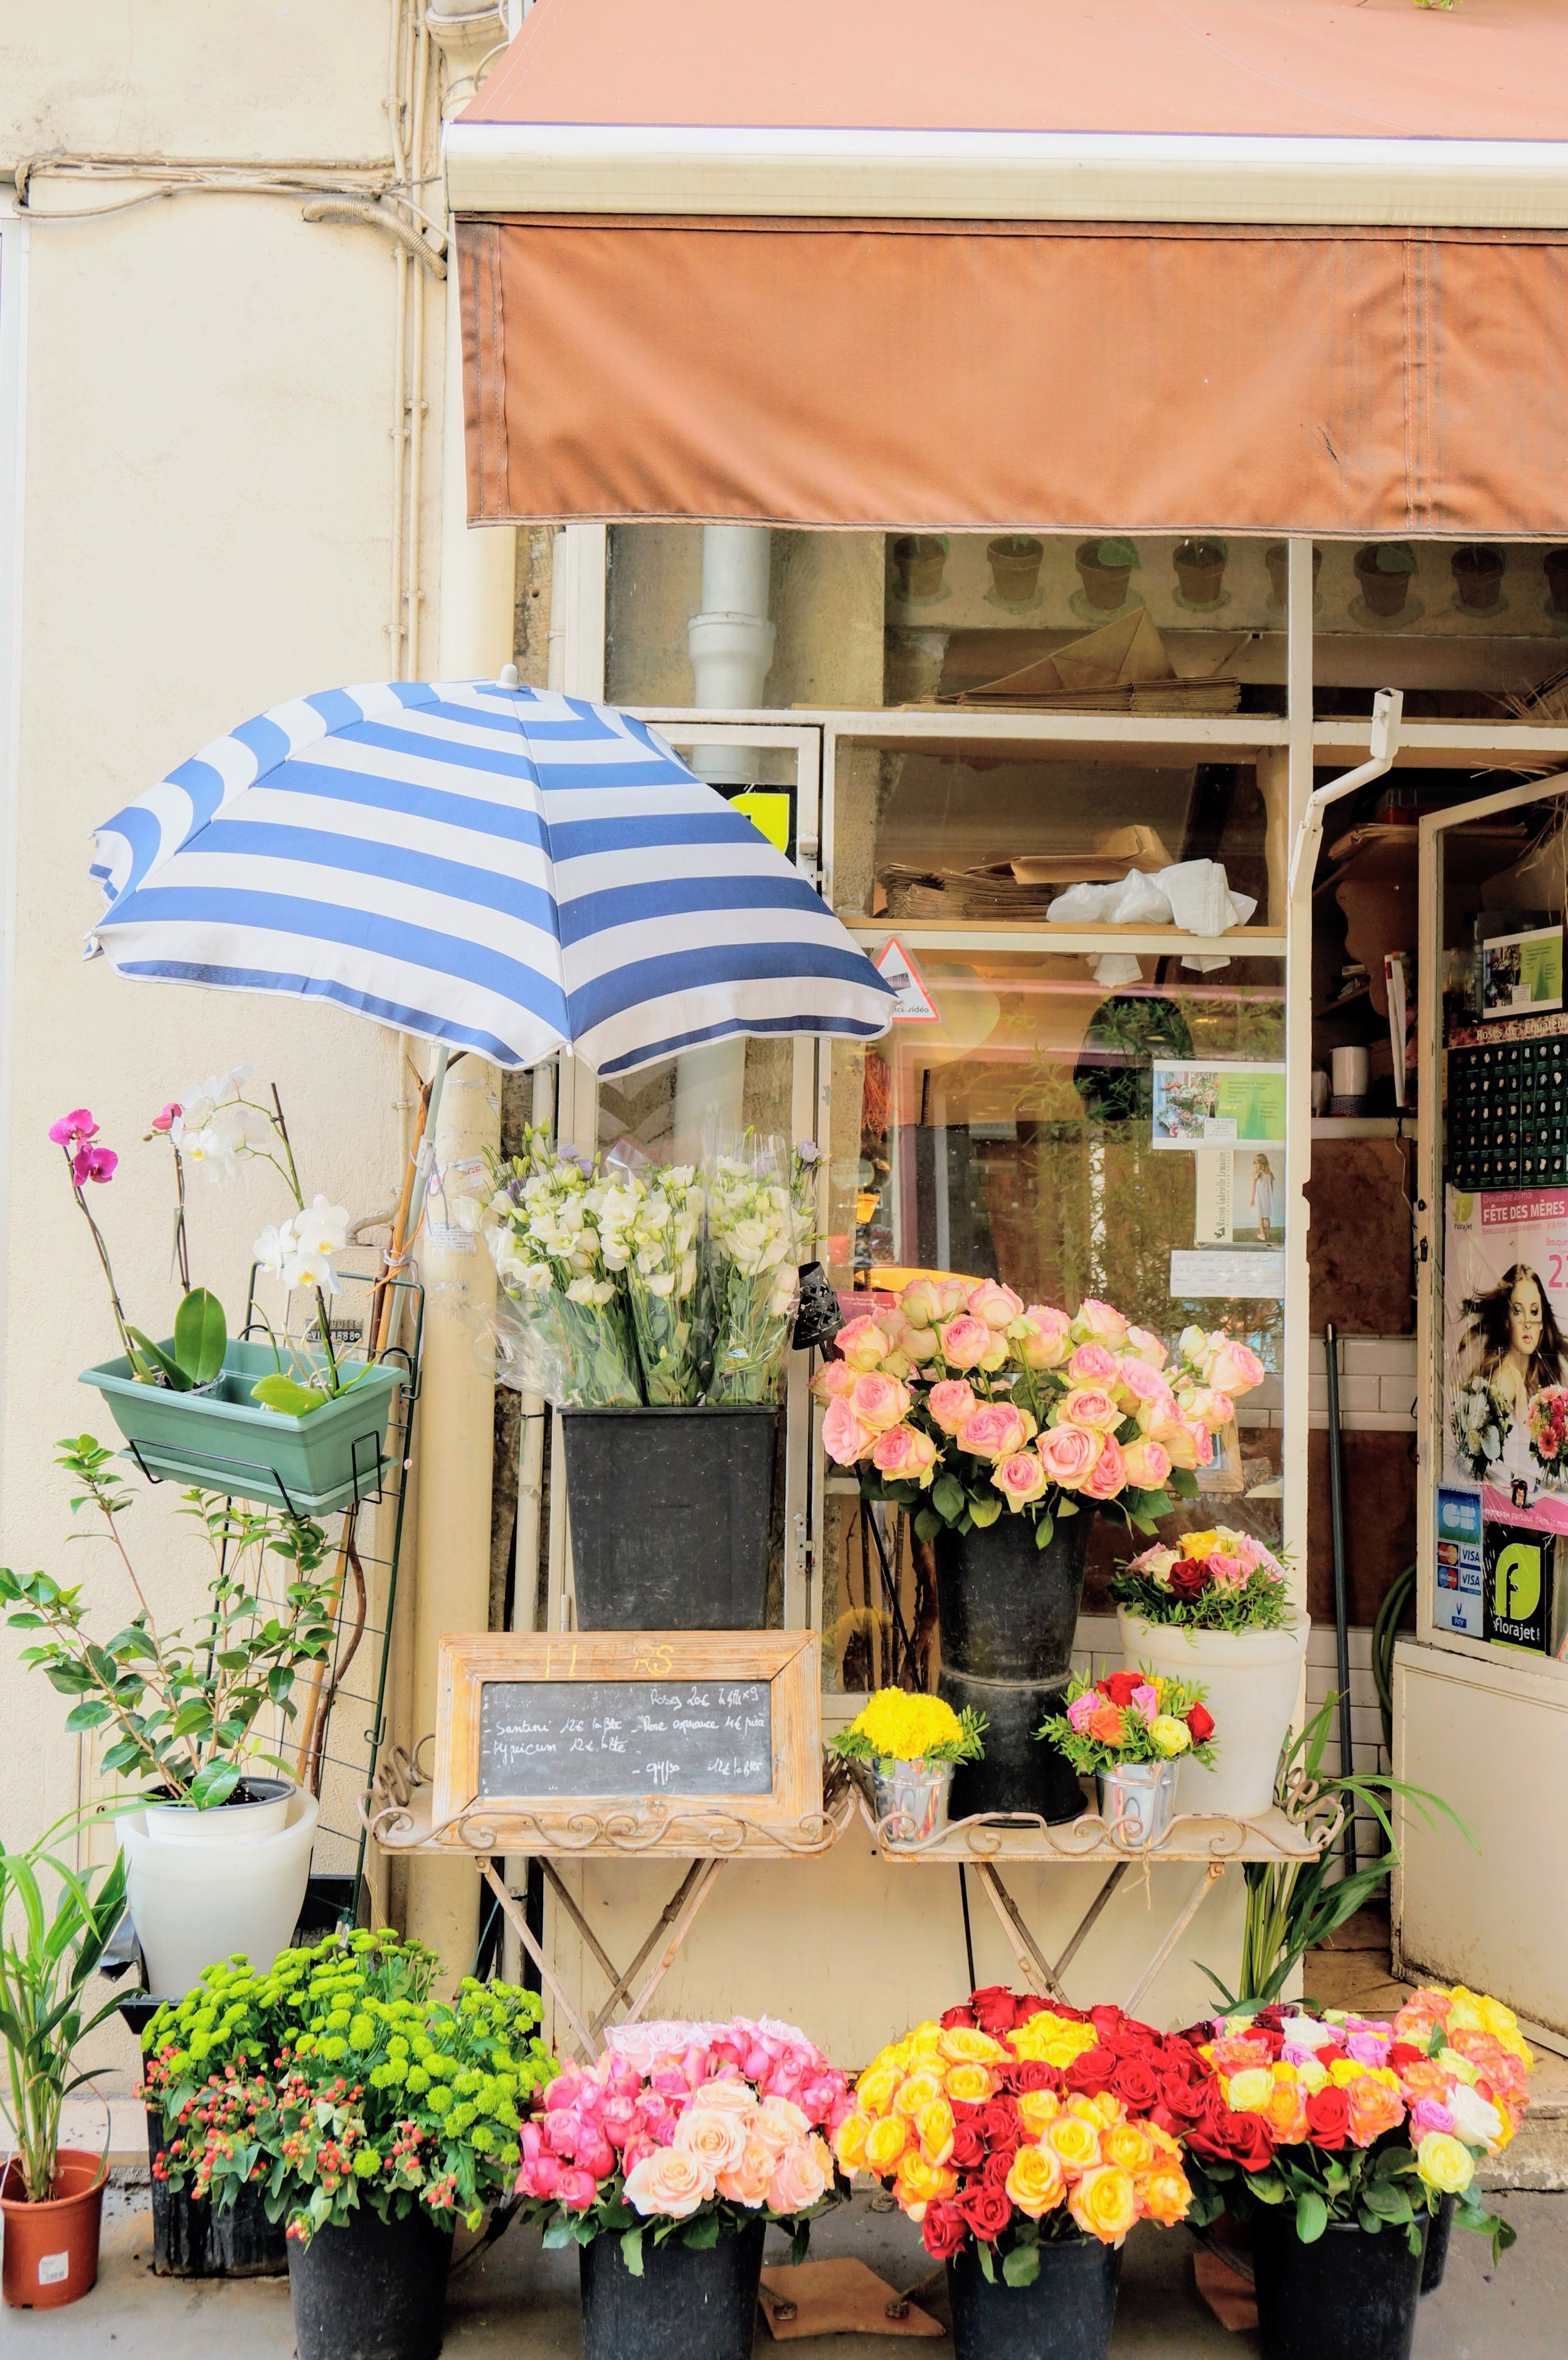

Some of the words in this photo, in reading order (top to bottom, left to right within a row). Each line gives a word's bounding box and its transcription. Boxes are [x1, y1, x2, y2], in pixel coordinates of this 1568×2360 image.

[1476, 1028, 1503, 1040] Roses
[1216, 1179, 1226, 1205] Gabrielle
[1216, 1206, 1226, 1226] Maison
[1483, 1204, 1508, 1223] FÊTE
[1510, 1204, 1528, 1220] DES
[1530, 1199, 1565, 1218] MÈRES
[1443, 1502, 1476, 1531] CB
[1511, 1512, 1534, 1523] partout
[1535, 1515, 1550, 1526] dans
[1462, 1548, 1480, 1562] VISA
[1462, 1573, 1481, 1587] VISA
[1454, 1617, 1465, 1627] PAY
[1495, 1617, 1535, 1641] florajet
